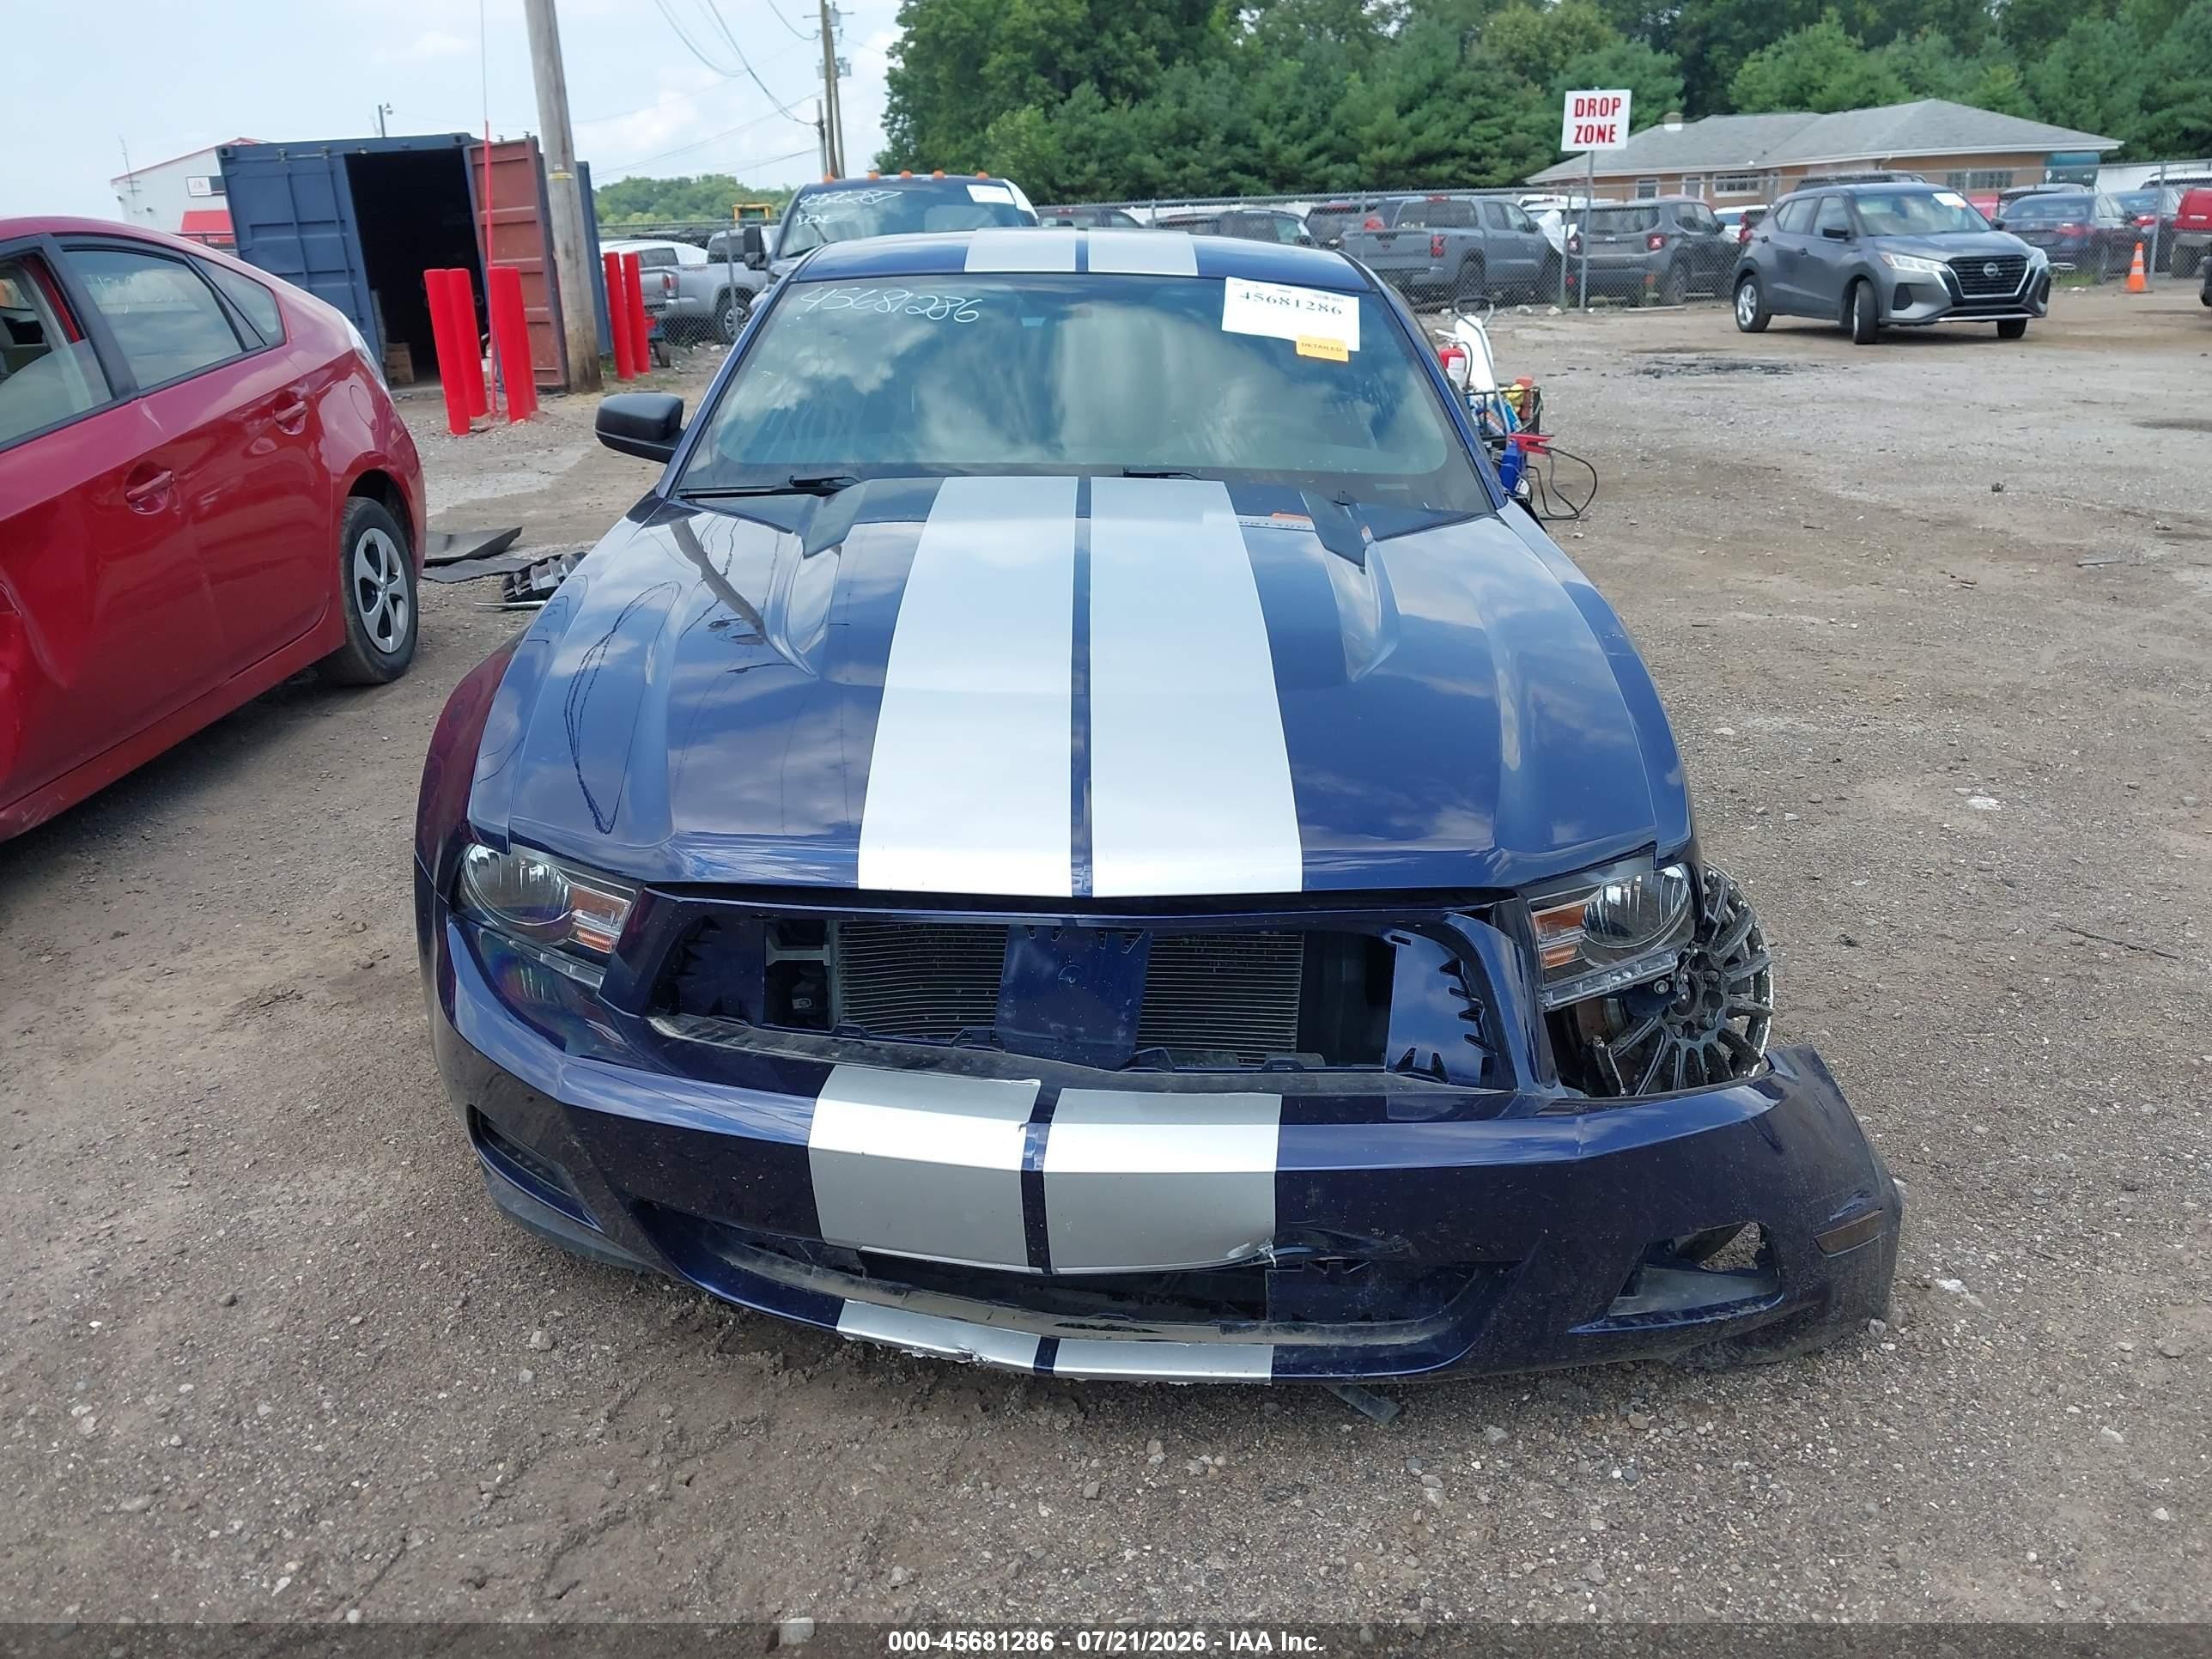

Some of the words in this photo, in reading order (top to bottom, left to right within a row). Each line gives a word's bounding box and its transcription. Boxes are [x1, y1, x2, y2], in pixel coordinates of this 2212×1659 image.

[1574, 97, 1621, 118] DROP
[1574, 124, 1617, 144] ZONE
[800, 287, 983, 324] 45681286
[1238, 290, 1343, 316] 45681286
[1300, 342, 1343, 353] DETAILED
